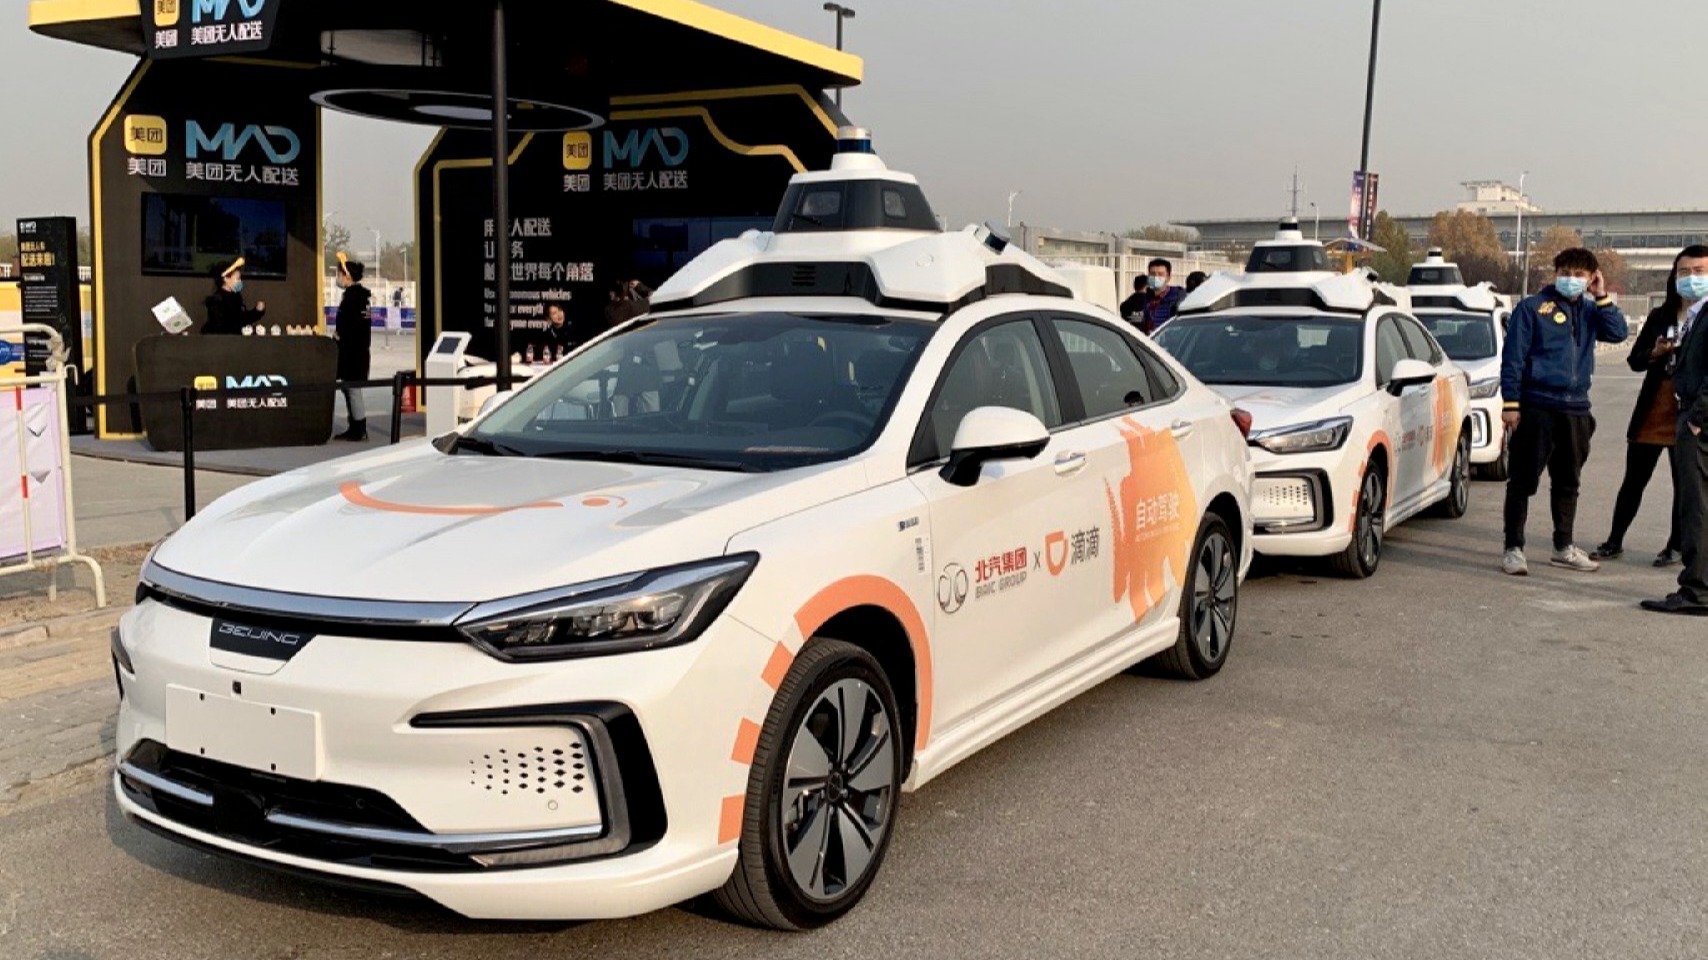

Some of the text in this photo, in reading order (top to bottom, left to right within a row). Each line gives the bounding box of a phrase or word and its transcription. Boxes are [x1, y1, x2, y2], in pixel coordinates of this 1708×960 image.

[155, 29, 178, 49] 美团
[191, 20, 263, 45] 美团无人配送
[130, 126, 163, 143] 美团
[566, 142, 589, 159] 美团
[127, 157, 167, 177] 美团
[185, 161, 300, 186] 美团无人配送
[563, 174, 591, 192] 美团
[603, 170, 688, 191] 美团无人配送
[484, 217, 552, 237] 用人配送
[483, 240, 524, 259] 让务
[517, 302, 544, 317] everyth
[975, 546, 1028, 583] 北汽集团
[1071, 525, 1100, 565] 滴滴
[999, 570, 1028, 592] GROUP
[219, 622, 300, 646] BEIJING
